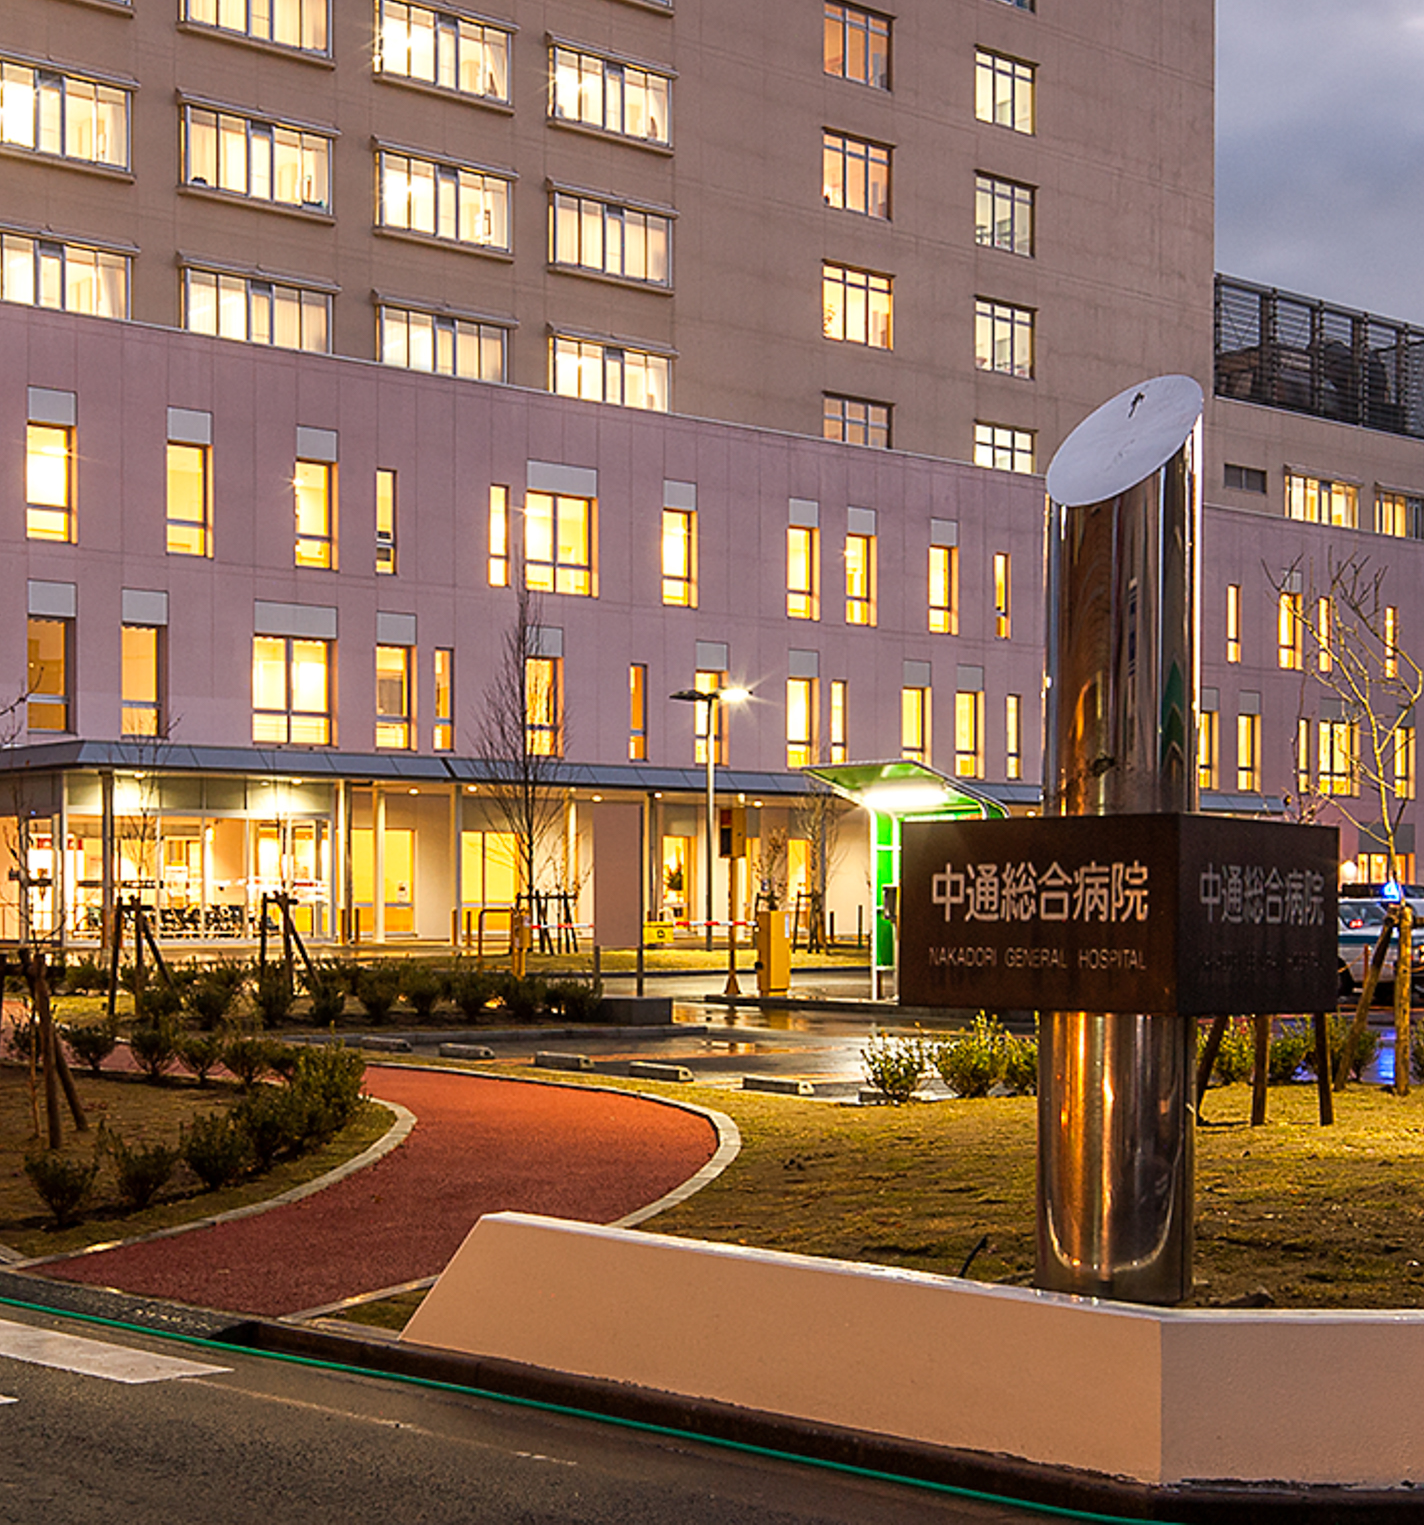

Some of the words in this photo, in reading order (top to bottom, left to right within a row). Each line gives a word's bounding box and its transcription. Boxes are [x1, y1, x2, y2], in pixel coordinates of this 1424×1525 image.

[931, 859, 1149, 923] 中通総合病院
[1199, 861, 1325, 926] 中通総合病院
[928, 946, 998, 967] NAKADORI
[1004, 946, 1068, 969] GENERAL
[1078, 948, 1148, 971] HOSPITAL
